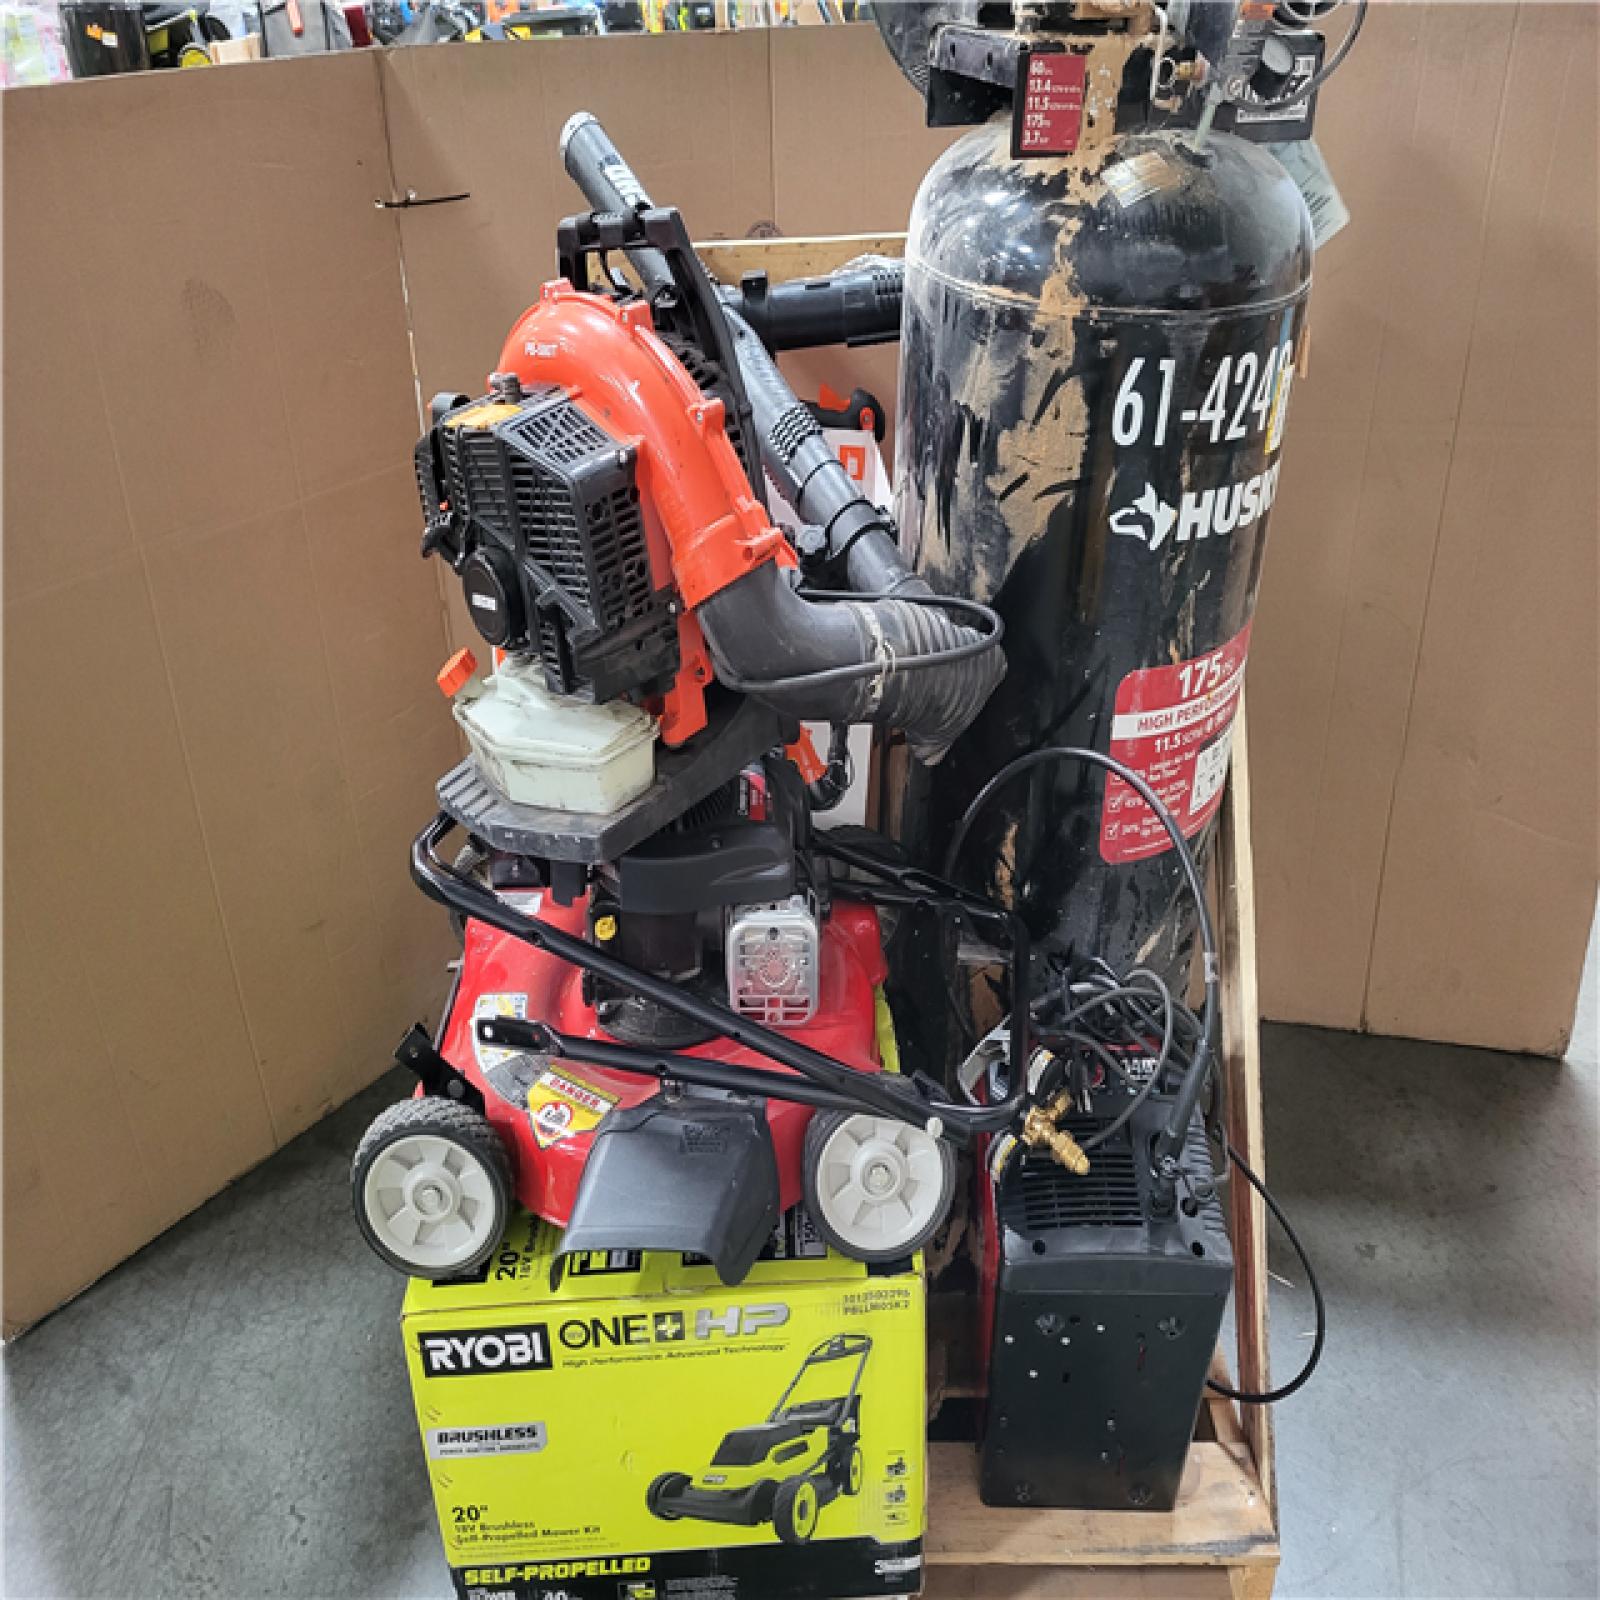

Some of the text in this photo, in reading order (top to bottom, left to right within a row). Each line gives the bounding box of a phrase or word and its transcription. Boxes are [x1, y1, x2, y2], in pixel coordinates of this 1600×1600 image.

[1028, 96, 1050, 111] 11.5
[1179, 651, 1224, 699] 175
[1137, 710, 1173, 732] HIGH
[1155, 732, 1181, 753] 11.5
[424, 1331, 545, 1372] RYOBI
[695, 1303, 790, 1340] HP
[438, 1424, 538, 1444] BRUSHLESS
[452, 1504, 488, 1523] 20"
[464, 1556, 651, 1586] SELF-PROPELLED
